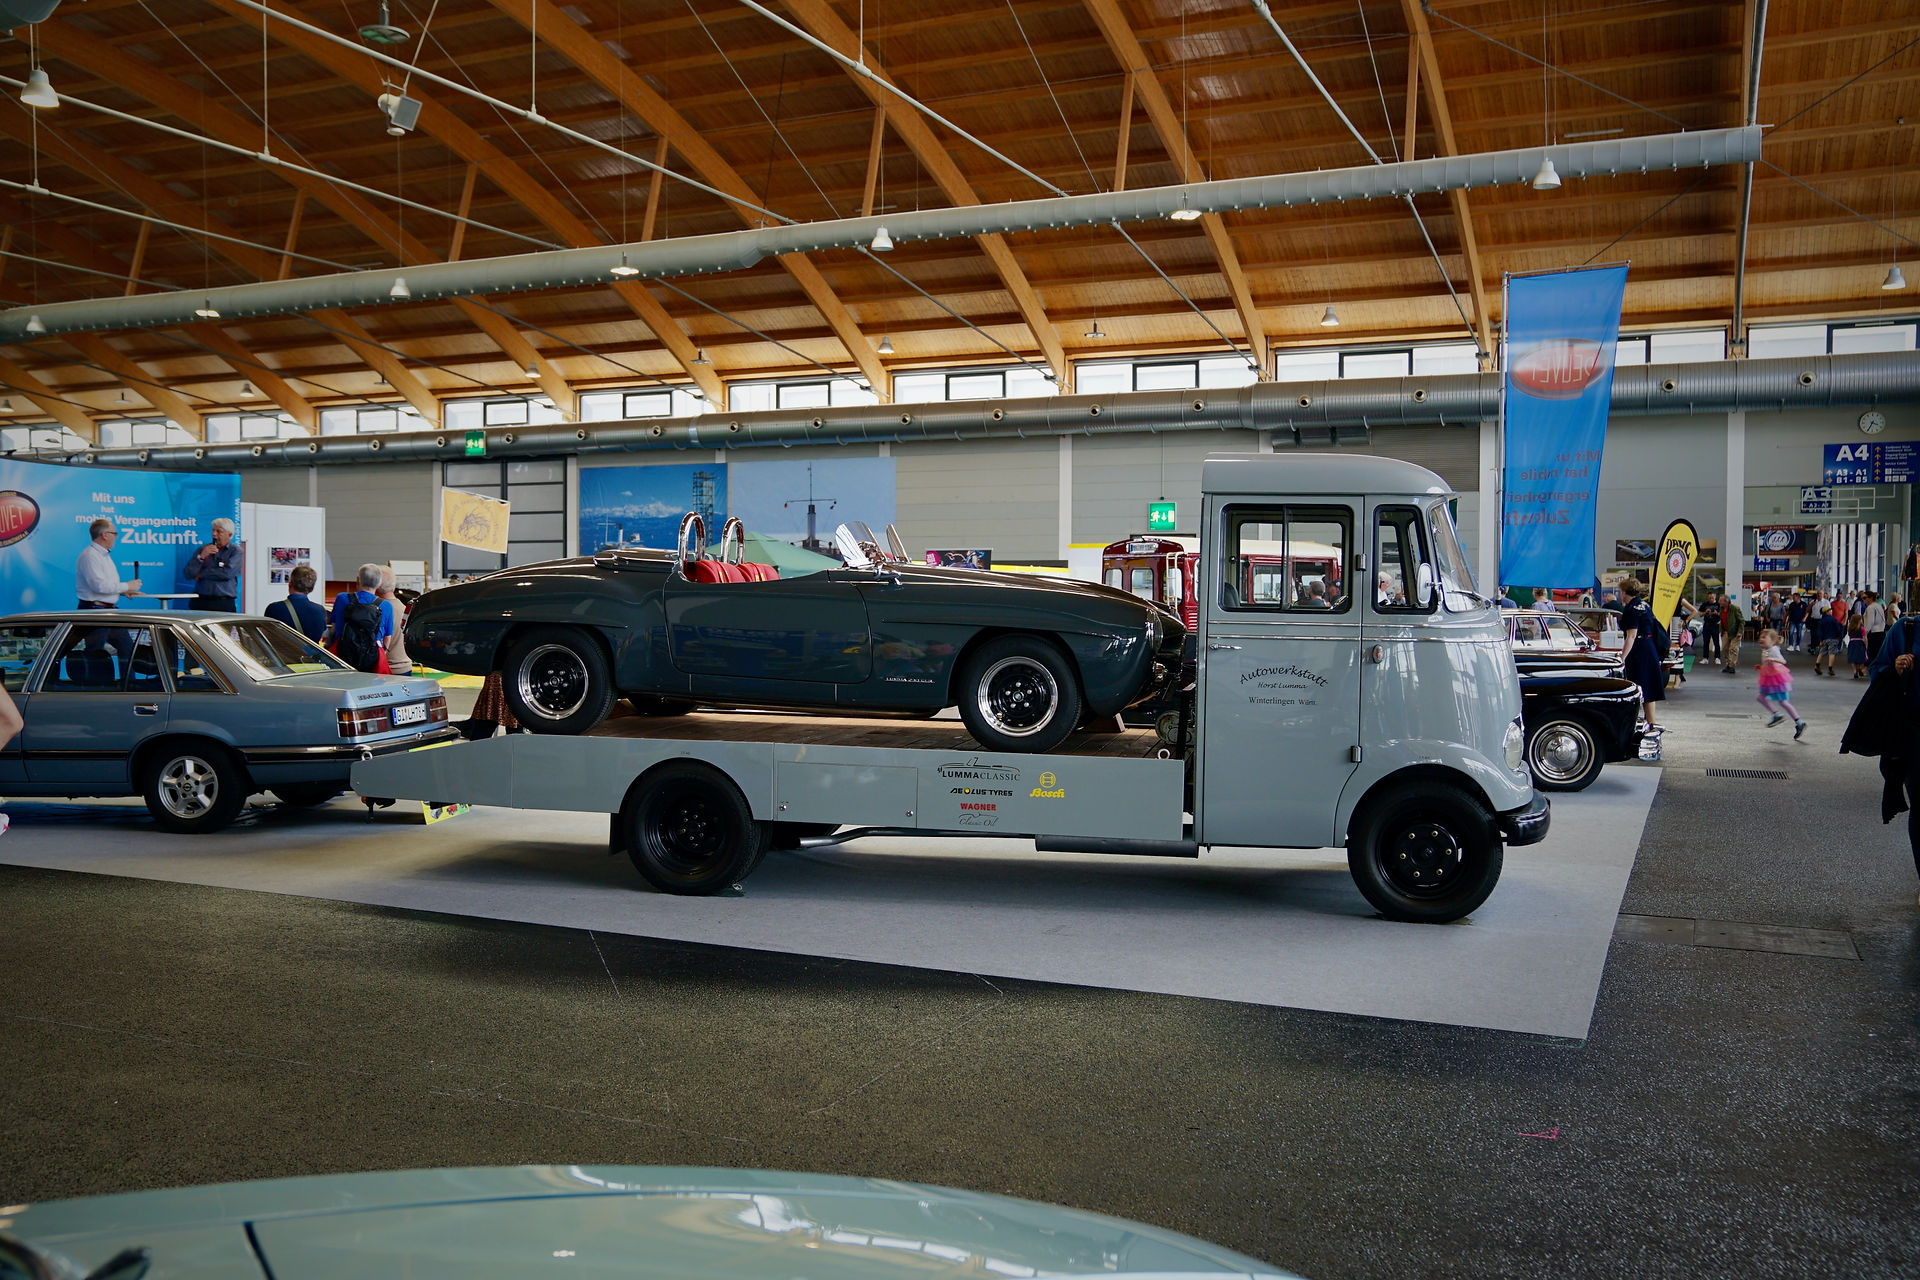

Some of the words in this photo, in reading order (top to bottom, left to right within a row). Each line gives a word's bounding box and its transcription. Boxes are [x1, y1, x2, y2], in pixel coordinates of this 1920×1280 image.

[1835, 444, 1869, 462] A4
[92, 492, 111, 503] Mit
[113, 495, 135, 504] uns
[1803, 487, 1831, 501] A3
[101, 505, 114, 513] hat
[114, 515, 197, 527] Vergangenheit
[121, 528, 203, 545] Zukunft.
[1240, 665, 1329, 688] Autowerkstatt
[1248, 696, 1295, 706] Winterlingen
[942, 770, 1021, 781] LUMMACLASSIC
[987, 789, 1014, 797] TYRES
[1029, 788, 1065, 798] Bosch
[960, 803, 997, 811] WAGNER
